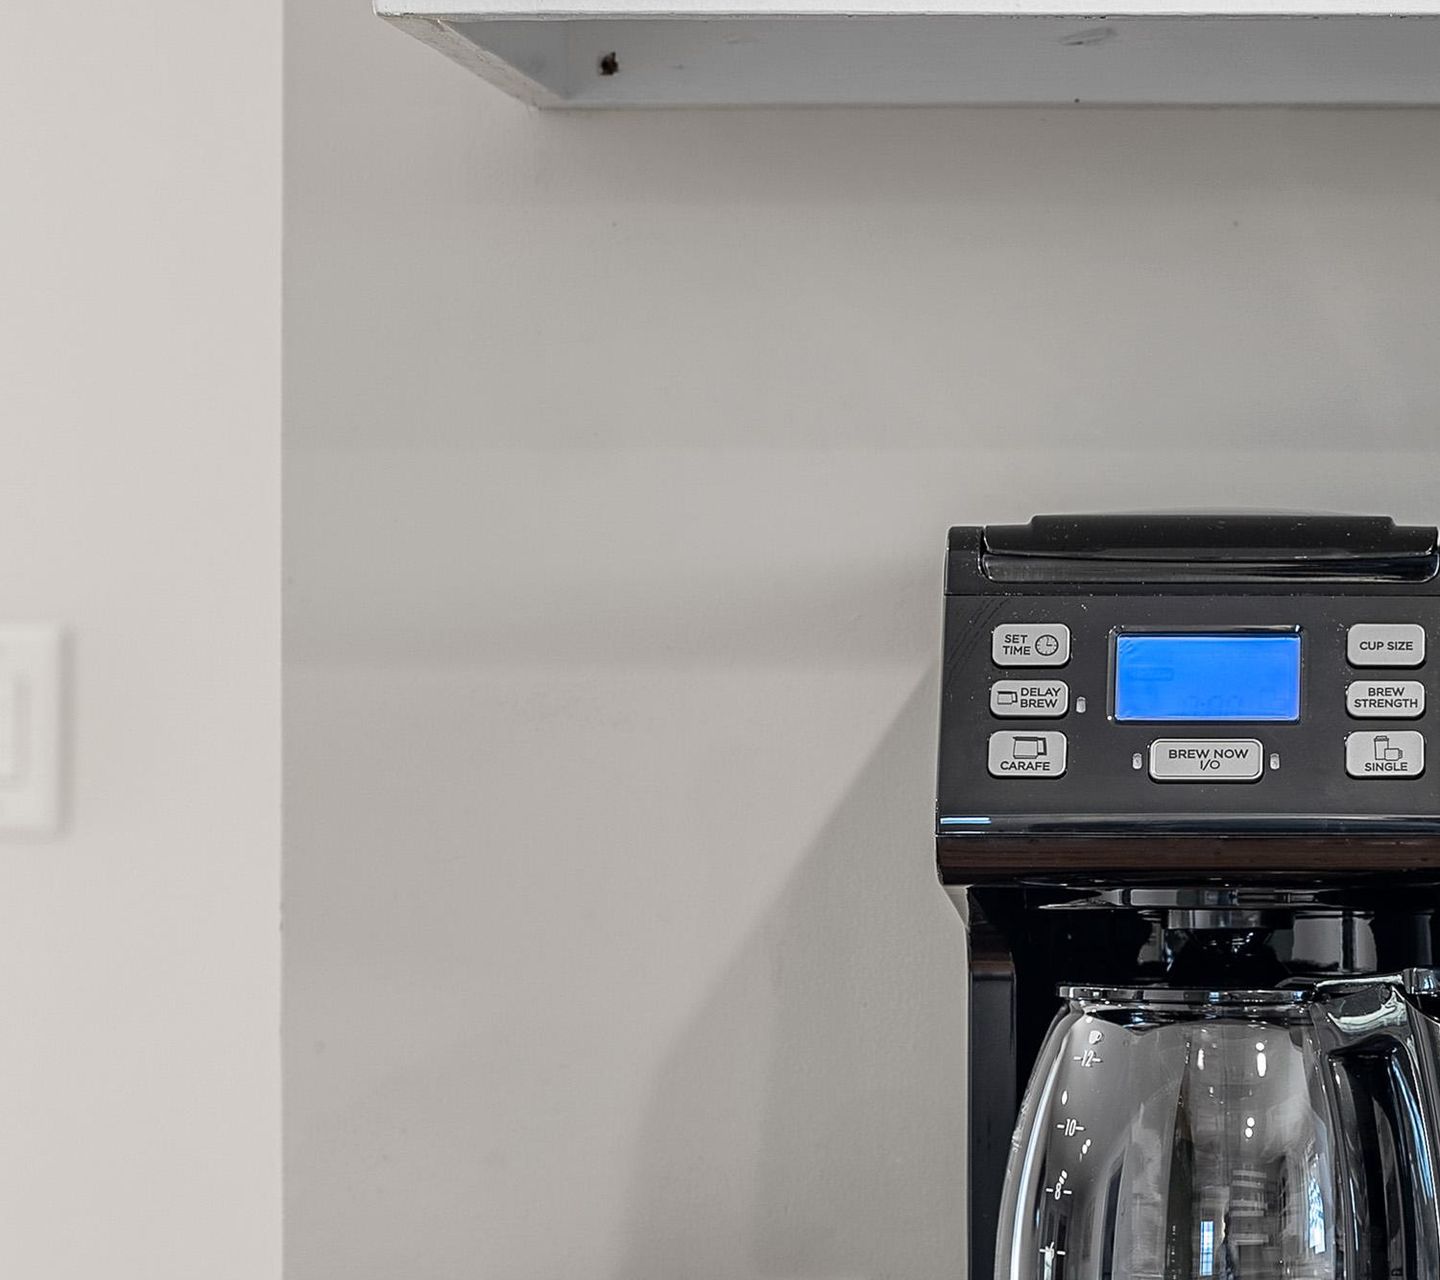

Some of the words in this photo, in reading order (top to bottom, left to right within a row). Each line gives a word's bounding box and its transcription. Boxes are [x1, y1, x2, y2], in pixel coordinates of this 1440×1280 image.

[1004, 634, 1028, 644] SET
[1003, 645, 1031, 655] TIME
[1359, 641, 1384, 651] CUP
[1387, 641, 1414, 651] SIZE
[1020, 687, 1061, 697] DELAY
[1368, 687, 1405, 697] BREW
[1020, 699, 1058, 708] BREW
[1354, 698, 1418, 708] STRENGTH
[1168, 749, 1210, 759] BREW
[1214, 749, 1249, 759] NOW
[1000, 761, 1051, 771] CARAFE
[1200, 759, 1221, 771] I/O
[1364, 762, 1408, 772] SINGLE
[1081, 1050, 1094, 1067] 12
[1064, 1119, 1077, 1136] 10
[1054, 1182, 1062, 1200] 8
